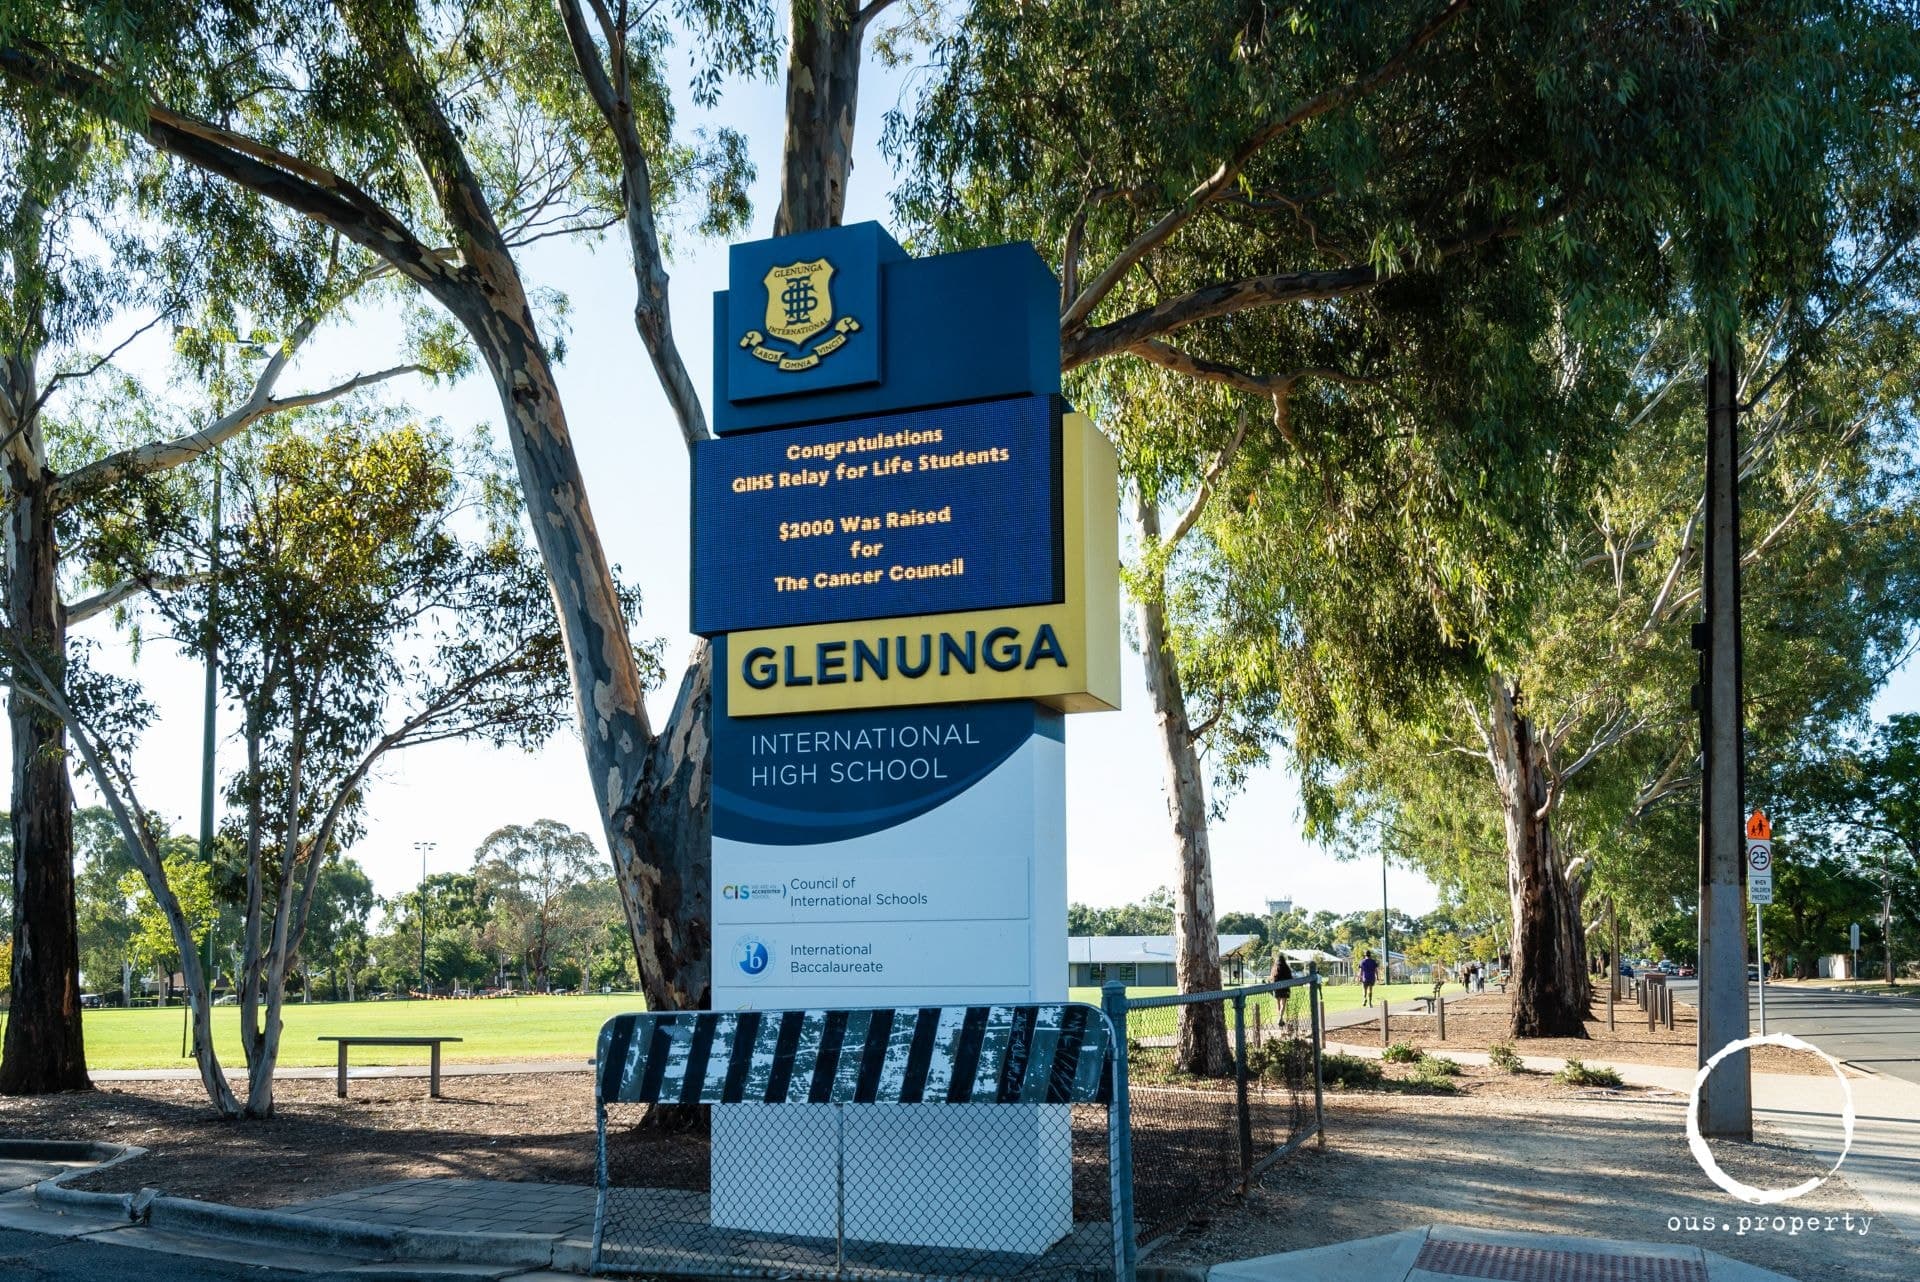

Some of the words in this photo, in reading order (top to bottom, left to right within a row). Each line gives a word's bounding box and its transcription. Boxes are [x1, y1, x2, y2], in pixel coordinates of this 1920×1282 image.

[774, 264, 823, 278] GLENUNGA
[768, 318, 827, 335] INTERNATIONAL
[817, 336, 843, 353] VINCIT
[754, 348, 779, 361] LABOR
[784, 359, 811, 369] OMNIA
[786, 429, 943, 461] Congratulations
[732, 473, 774, 493] GIHS
[779, 468, 830, 487] Relay
[835, 462, 868, 480] for
[872, 456, 913, 476] Life
[918, 447, 1009, 471] Students
[779, 519, 834, 542] $2000
[840, 516, 881, 533] Was
[886, 505, 952, 528] Raised
[849, 540, 884, 559] for
[774, 576, 809, 593] The
[813, 569, 884, 589] Cancer
[888, 557, 964, 581] Council
[742, 623, 1068, 690] GLENUNGA
[752, 723, 980, 755] INTERNATIONAL
[752, 763, 817, 787] HIGH
[830, 757, 948, 783] SCHOOL
[1752, 851, 1768, 864] 25
[790, 877, 838, 890] Council
[842, 877, 856, 889] of
[722, 885, 750, 900] CIS
[790, 893, 871, 907] International
[876, 892, 928, 905] Schools
[790, 943, 872, 956] International
[790, 961, 884, 973] Baccalaureate
